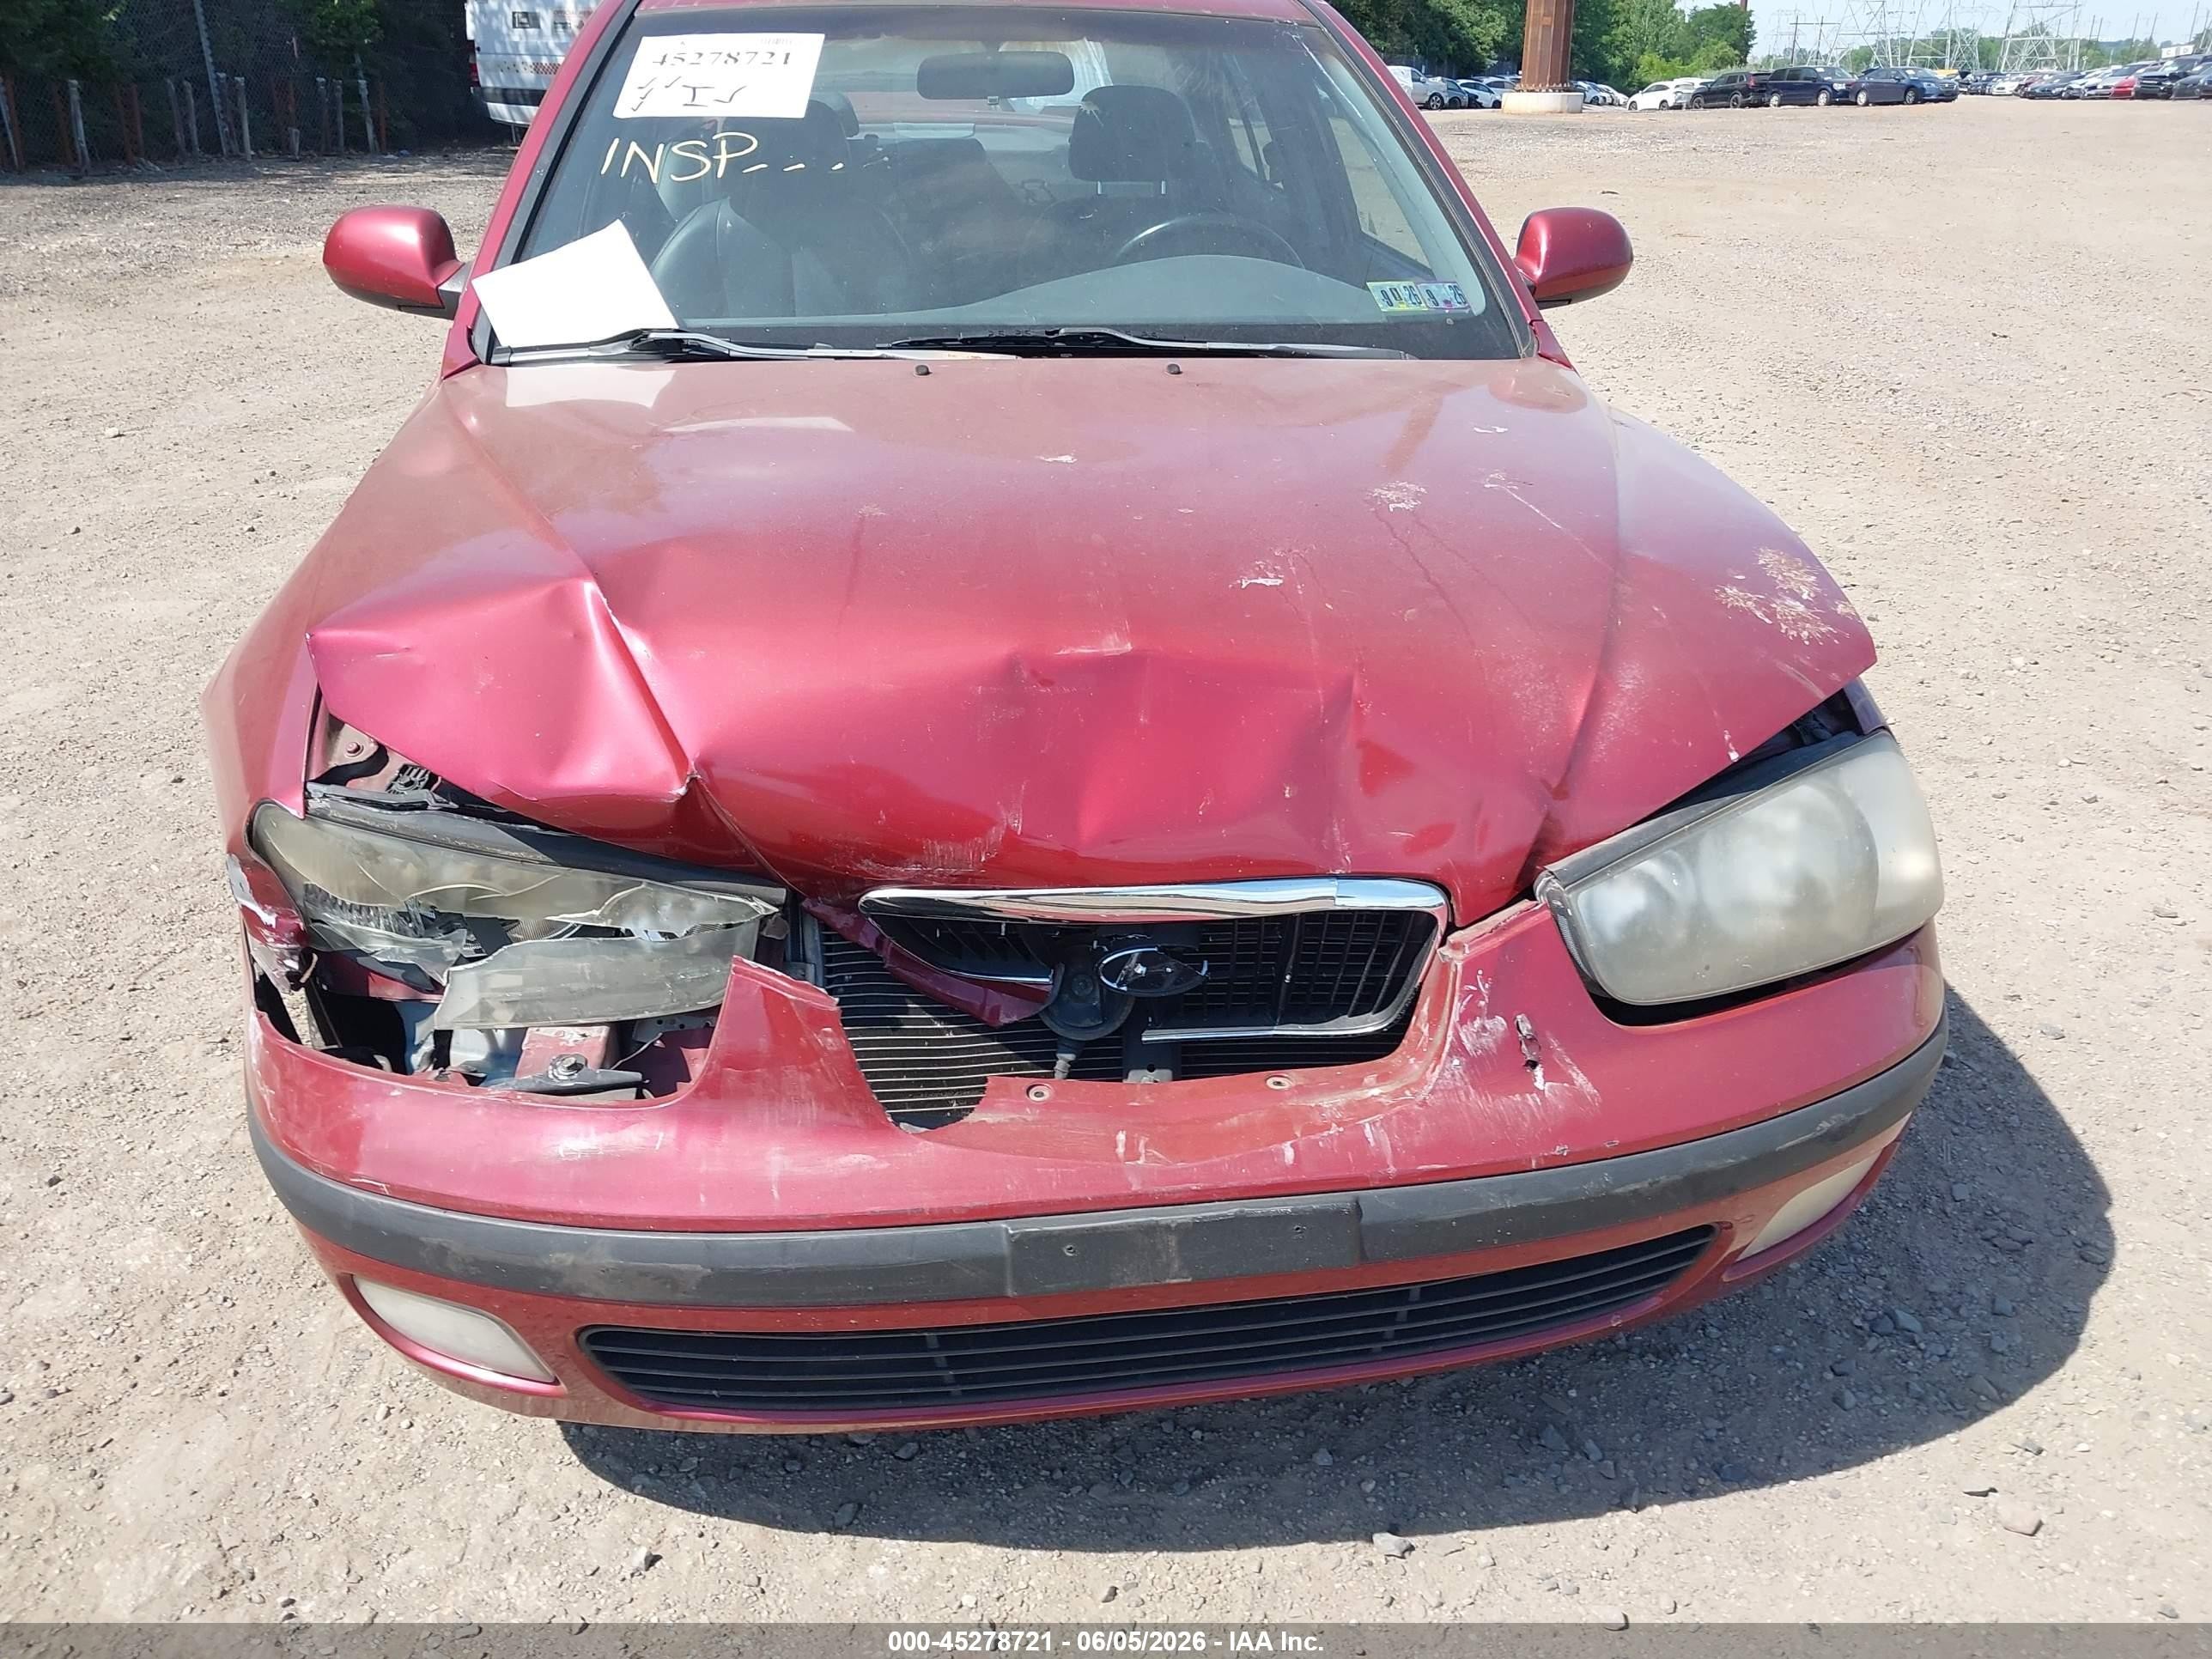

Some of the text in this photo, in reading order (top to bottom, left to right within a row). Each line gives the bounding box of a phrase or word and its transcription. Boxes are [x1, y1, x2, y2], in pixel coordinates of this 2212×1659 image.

[652, 51, 791, 66] 45278721
[1403, 285, 1422, 305] 26
[1448, 285, 1467, 305] 26
